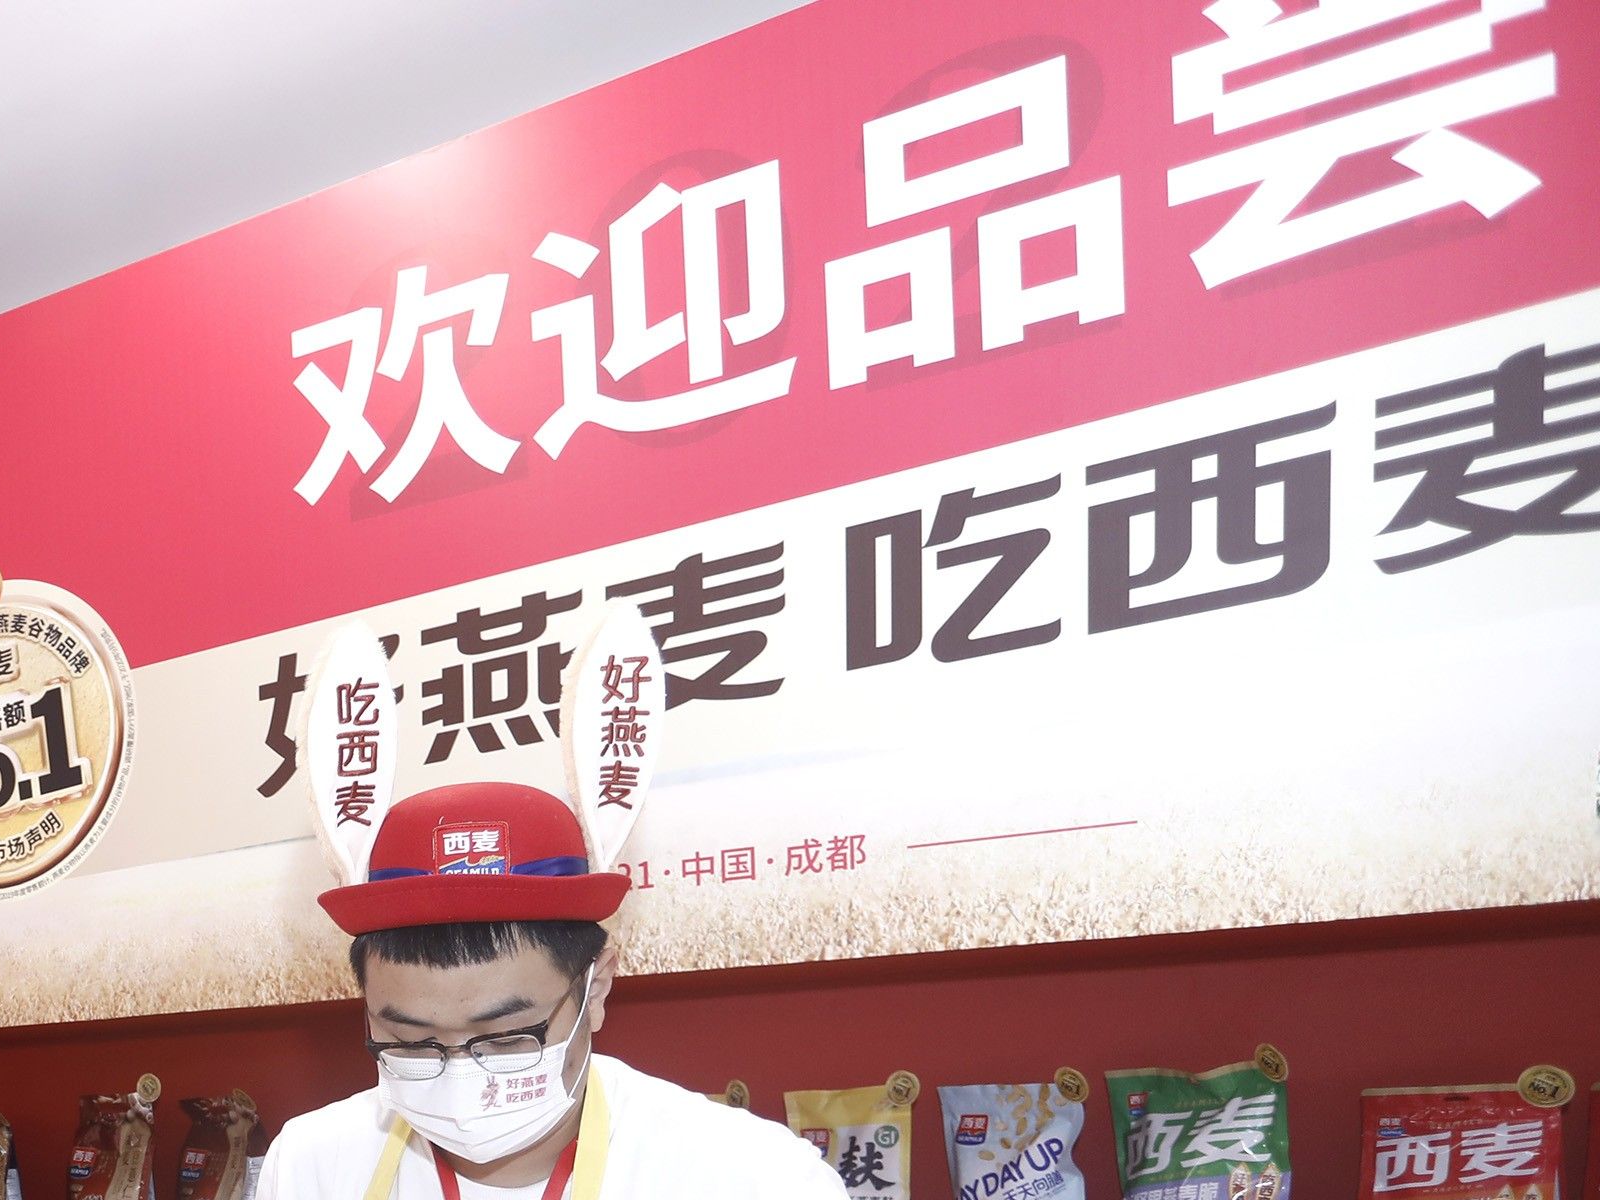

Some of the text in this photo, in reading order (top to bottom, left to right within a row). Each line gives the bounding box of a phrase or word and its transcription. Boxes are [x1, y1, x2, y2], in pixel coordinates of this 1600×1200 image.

[292, 0, 1557, 506] 欢迎品尝
[845, 344, 1600, 672] 吃西麦
[334, 677, 380, 828] 吃西麦
[597, 655, 652, 810] 好燕麦
[443, 830, 500, 855] 西麦
[506, 1073, 548, 1090] 好燕麦
[506, 1087, 547, 1104] 吃西麦
[982, 1154, 1024, 1197] DAY
[1024, 1138, 1064, 1171] UP
[1126, 1093, 1276, 1181] 西麦
[1373, 1120, 1543, 1192] 西麦
